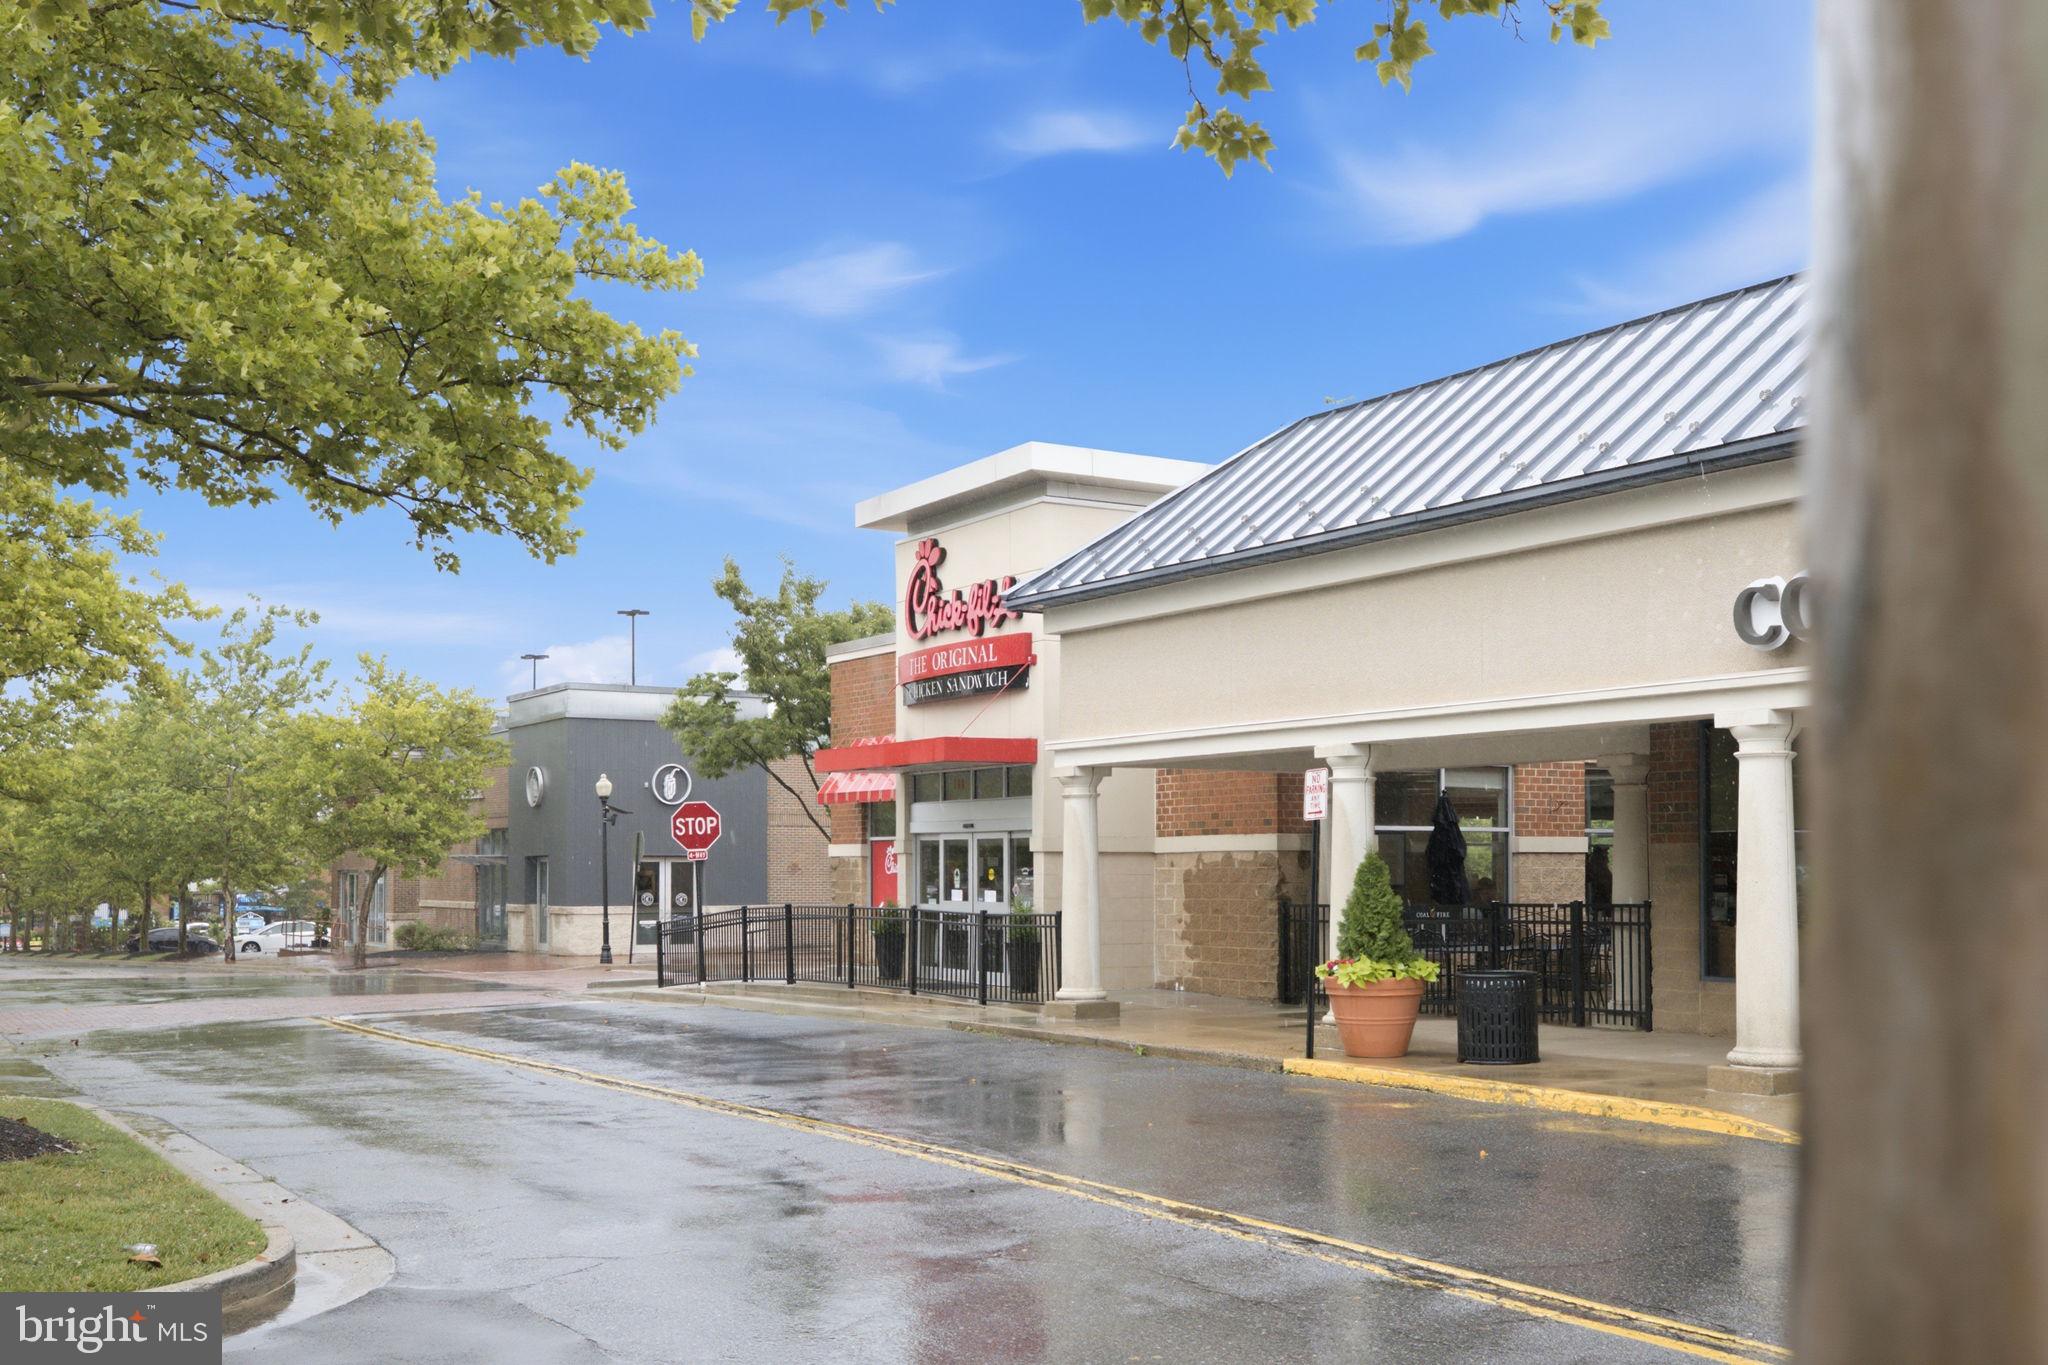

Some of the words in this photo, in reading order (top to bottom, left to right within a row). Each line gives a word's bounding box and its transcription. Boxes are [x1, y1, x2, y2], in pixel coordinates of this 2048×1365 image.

[909, 655, 928, 676] THE
[931, 643, 998, 671] ORIGINAL
[946, 670, 1008, 693] SANDWICH
[1305, 784, 1327, 794] PARKING
[1311, 774, 1321, 784] NO
[675, 816, 718, 836] STOP
